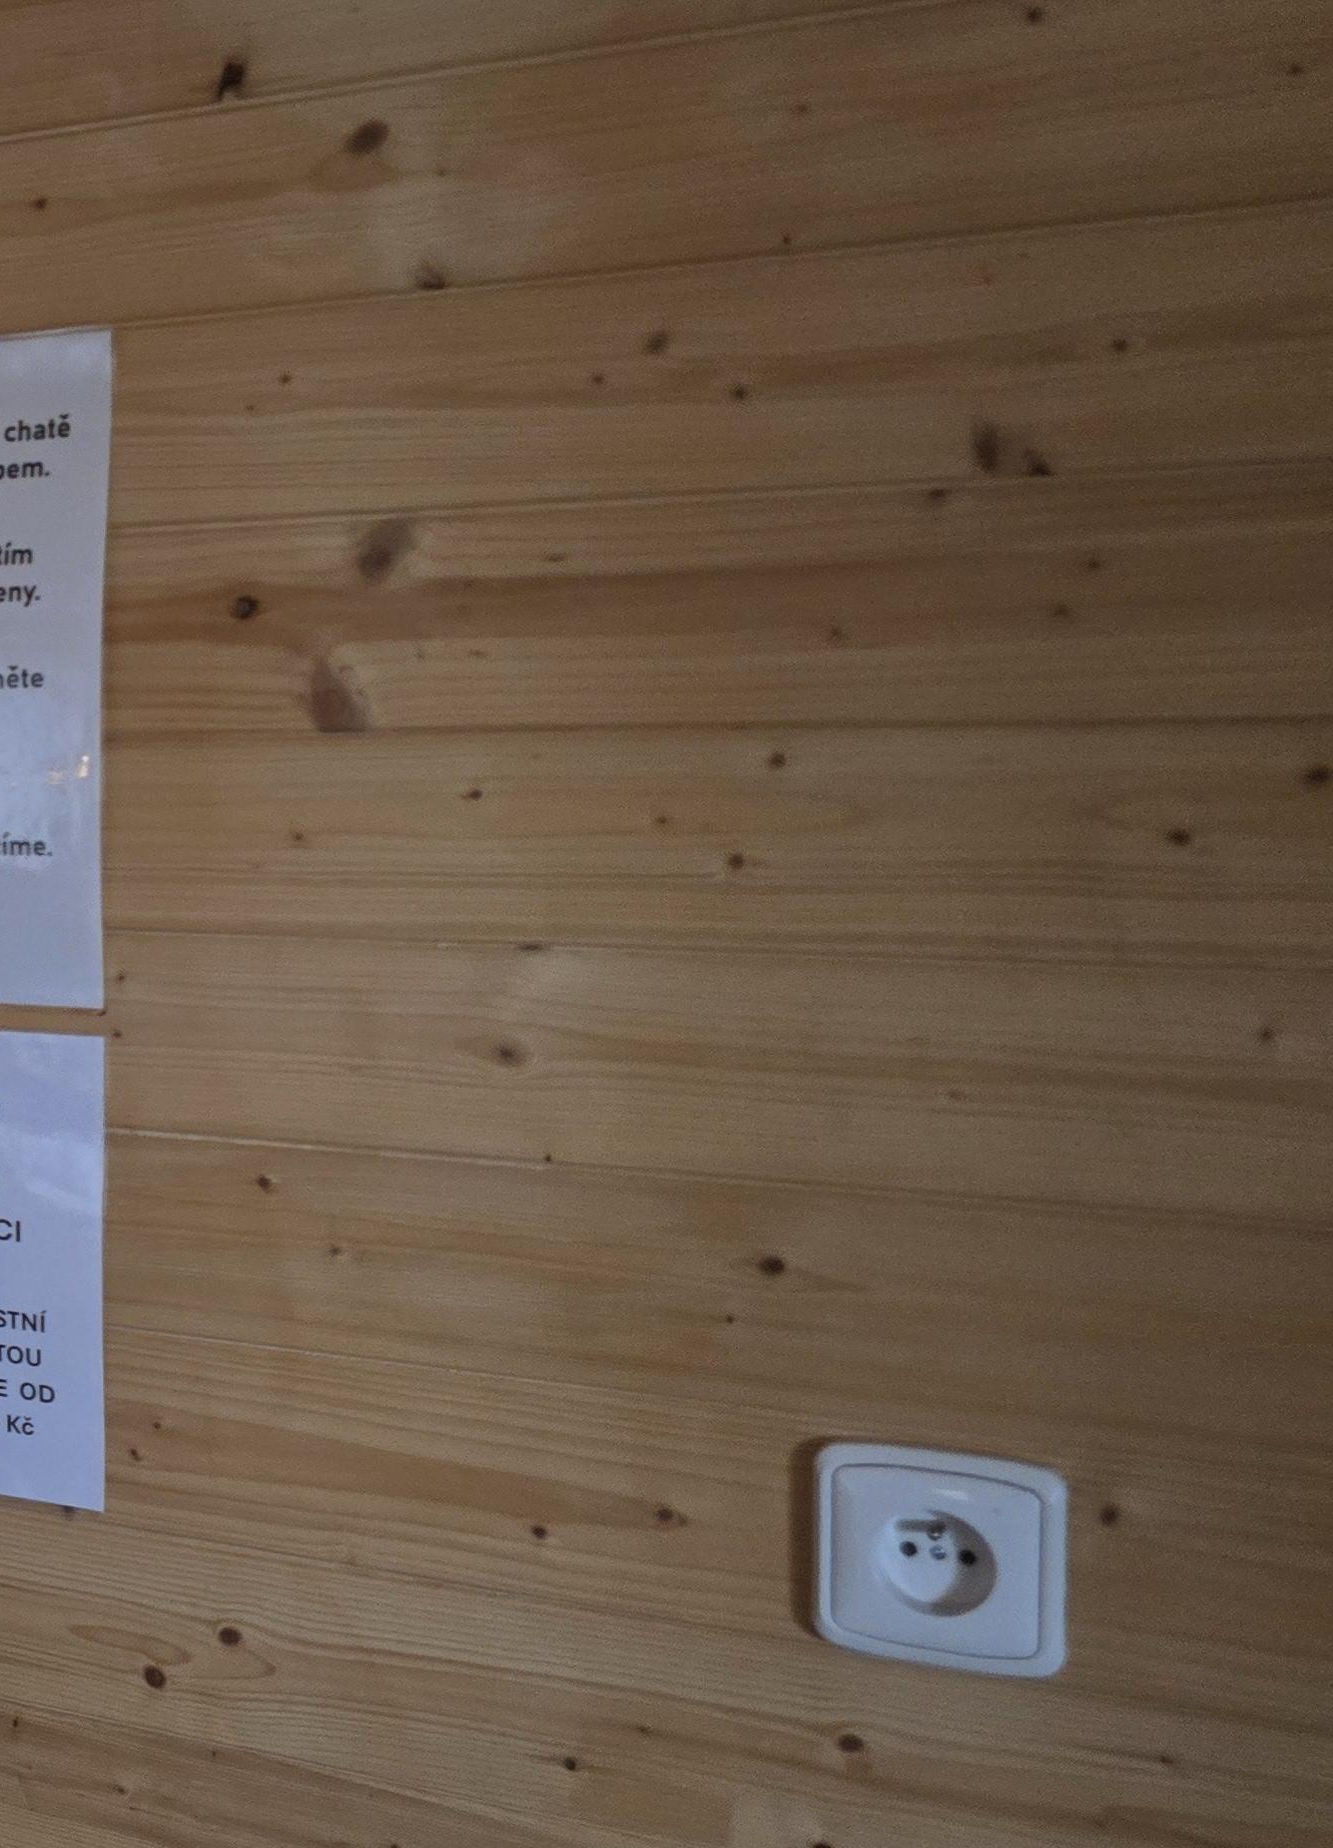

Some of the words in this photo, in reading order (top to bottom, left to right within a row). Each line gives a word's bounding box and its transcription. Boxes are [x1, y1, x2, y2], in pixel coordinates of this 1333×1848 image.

[4, 413, 71, 443] chatě
[19, 1382, 56, 1404] OD
[6, 1414, 35, 1436] Kč
